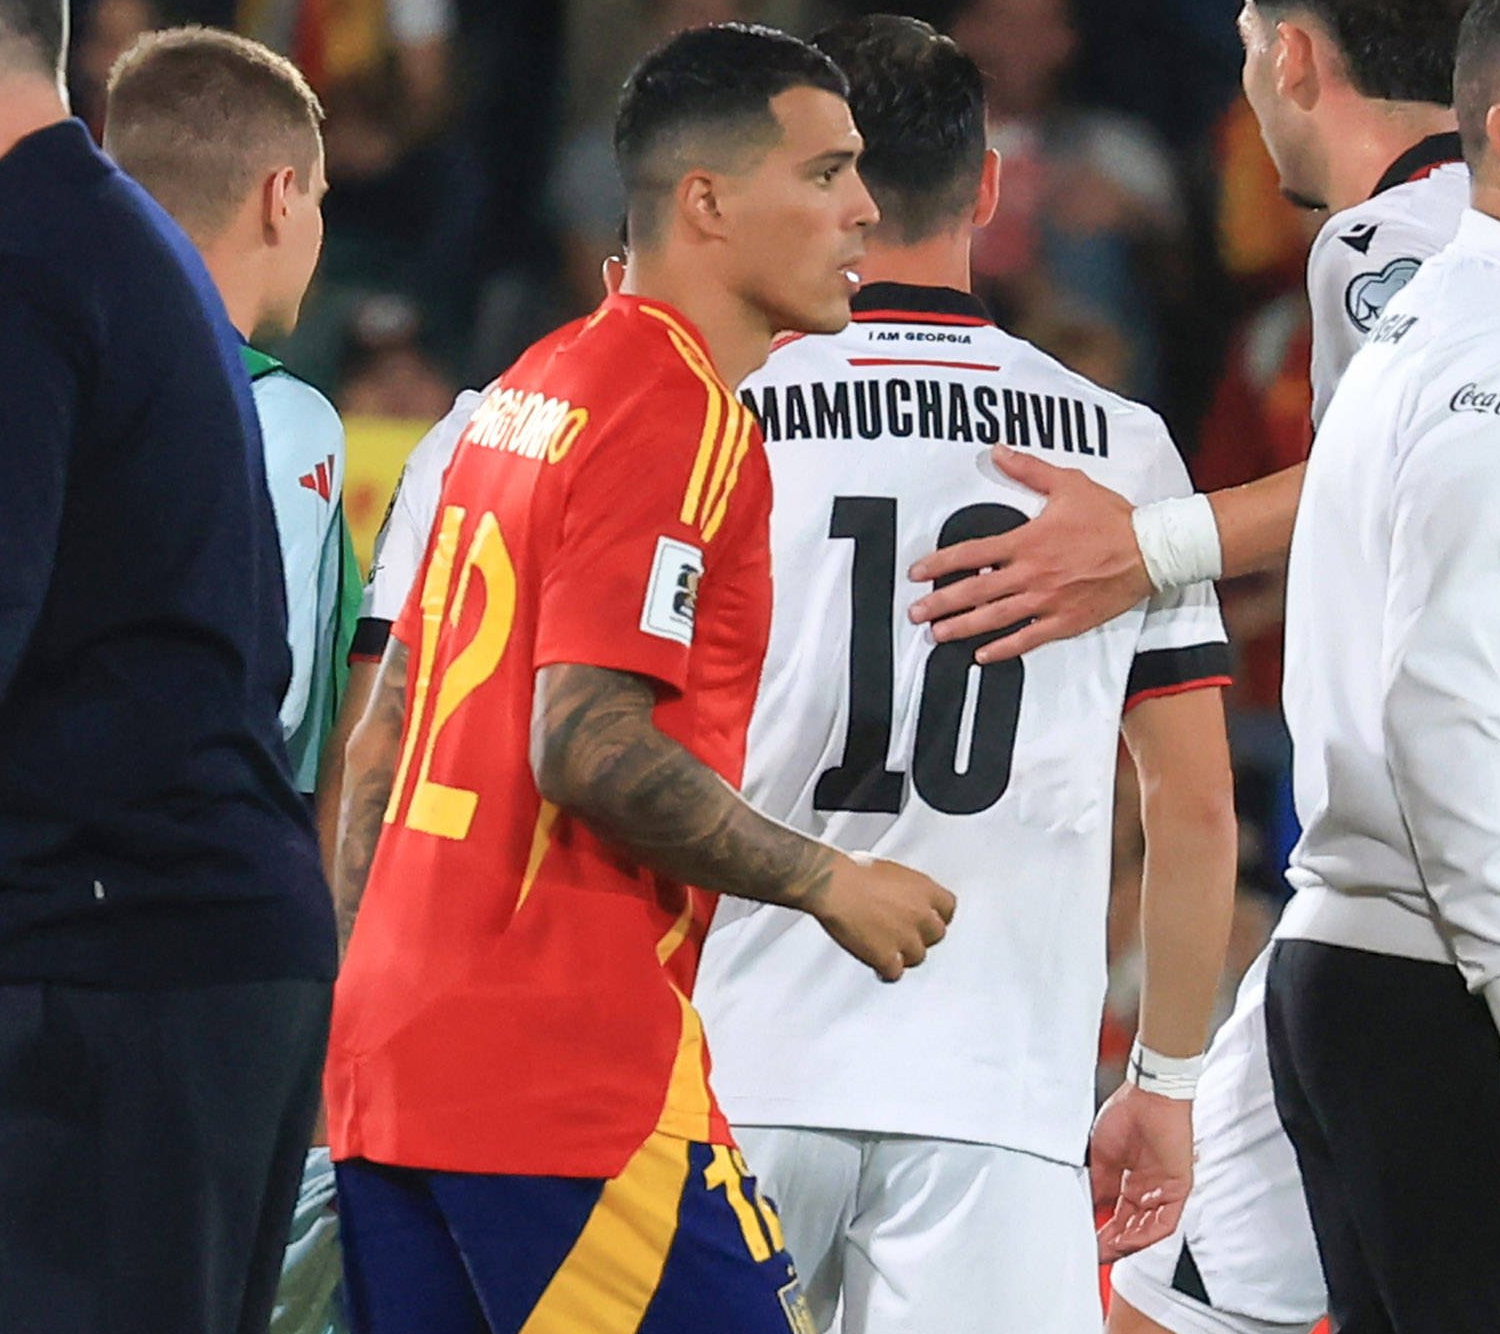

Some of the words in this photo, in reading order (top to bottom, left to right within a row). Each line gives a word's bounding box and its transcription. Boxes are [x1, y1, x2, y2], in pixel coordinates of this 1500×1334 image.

[876, 331, 901, 342] AM
[904, 332, 973, 344] GEORGIA
[740, 377, 1109, 459] MAMUCHASHVILI
[383, 505, 518, 841] 12
